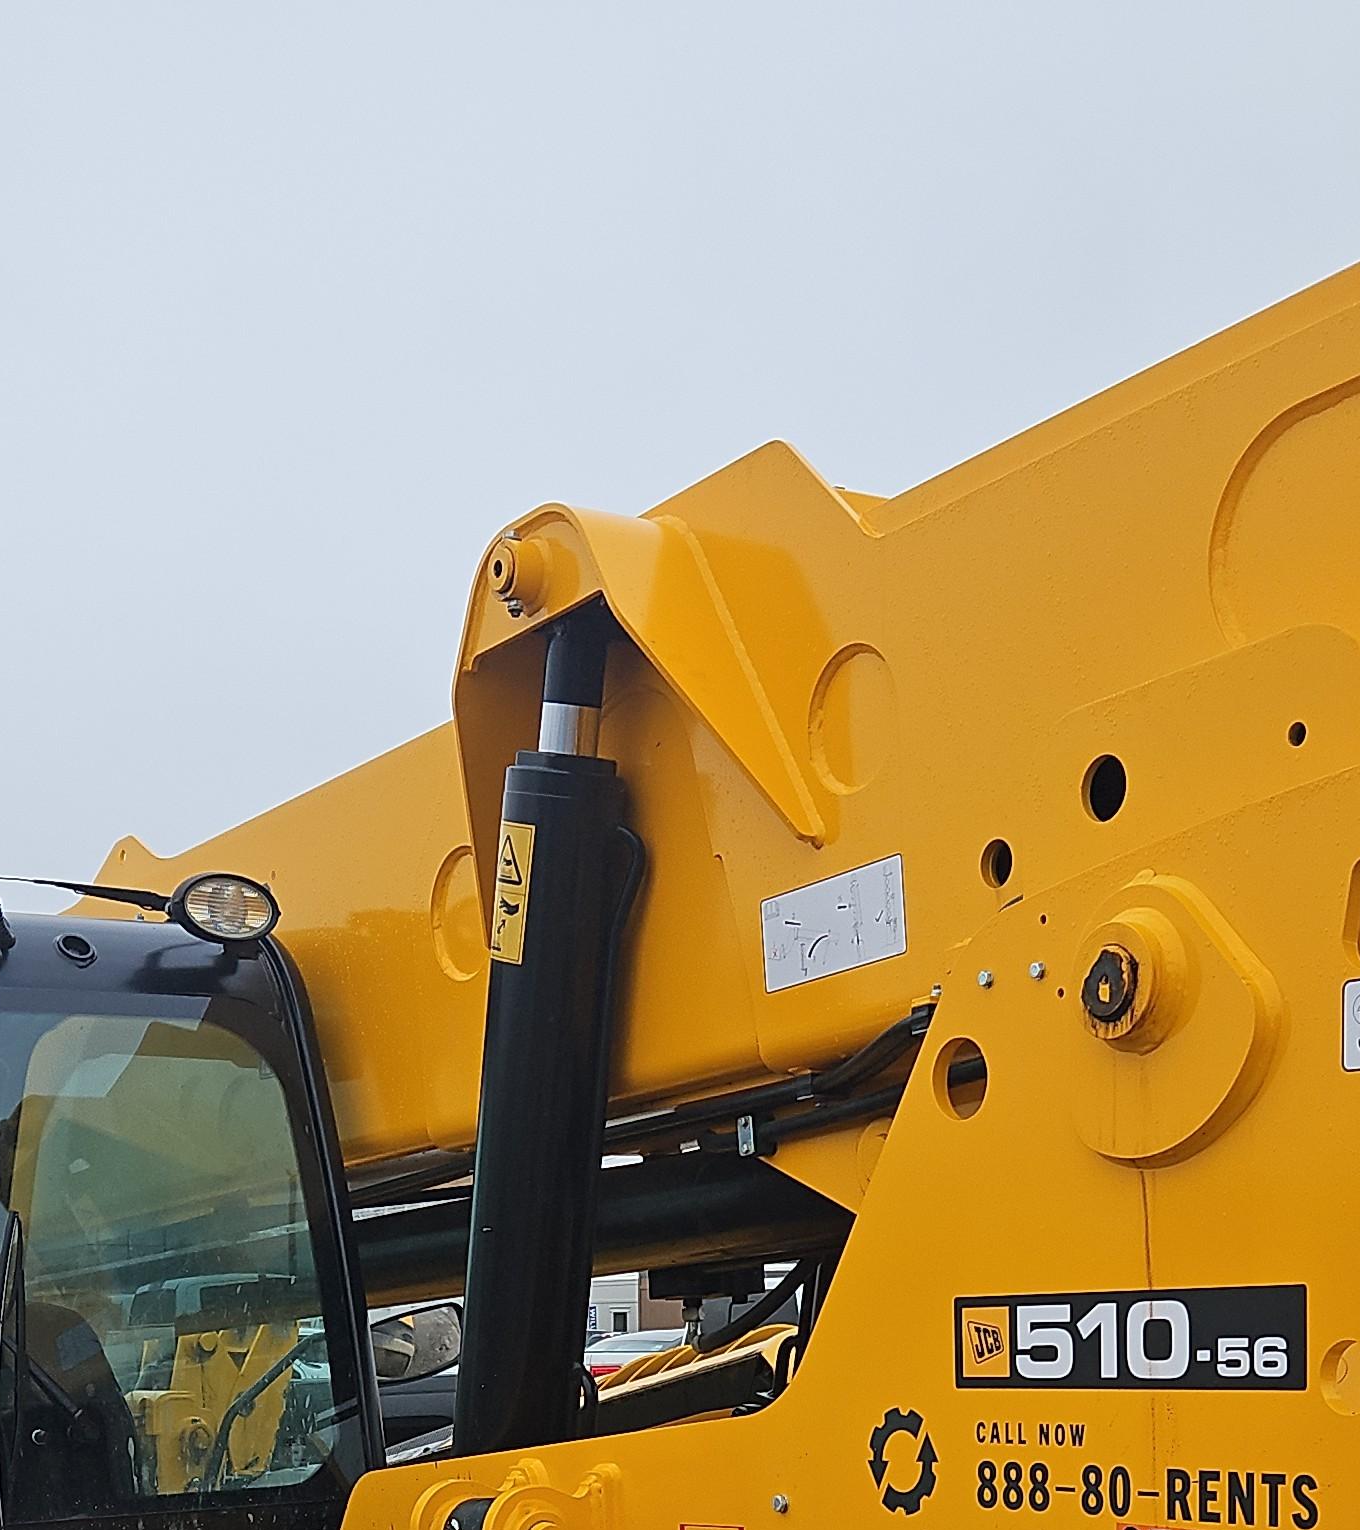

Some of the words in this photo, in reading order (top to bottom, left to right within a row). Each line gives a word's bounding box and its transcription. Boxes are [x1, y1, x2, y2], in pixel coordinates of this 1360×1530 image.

[973, 1325, 1002, 1359] JCB
[1015, 1300, 1288, 1380] 510-56
[976, 1422, 1027, 1445] CALL
[1039, 1423, 1086, 1447] NOW
[976, 1460, 1320, 1530] 888-80-RENTS
